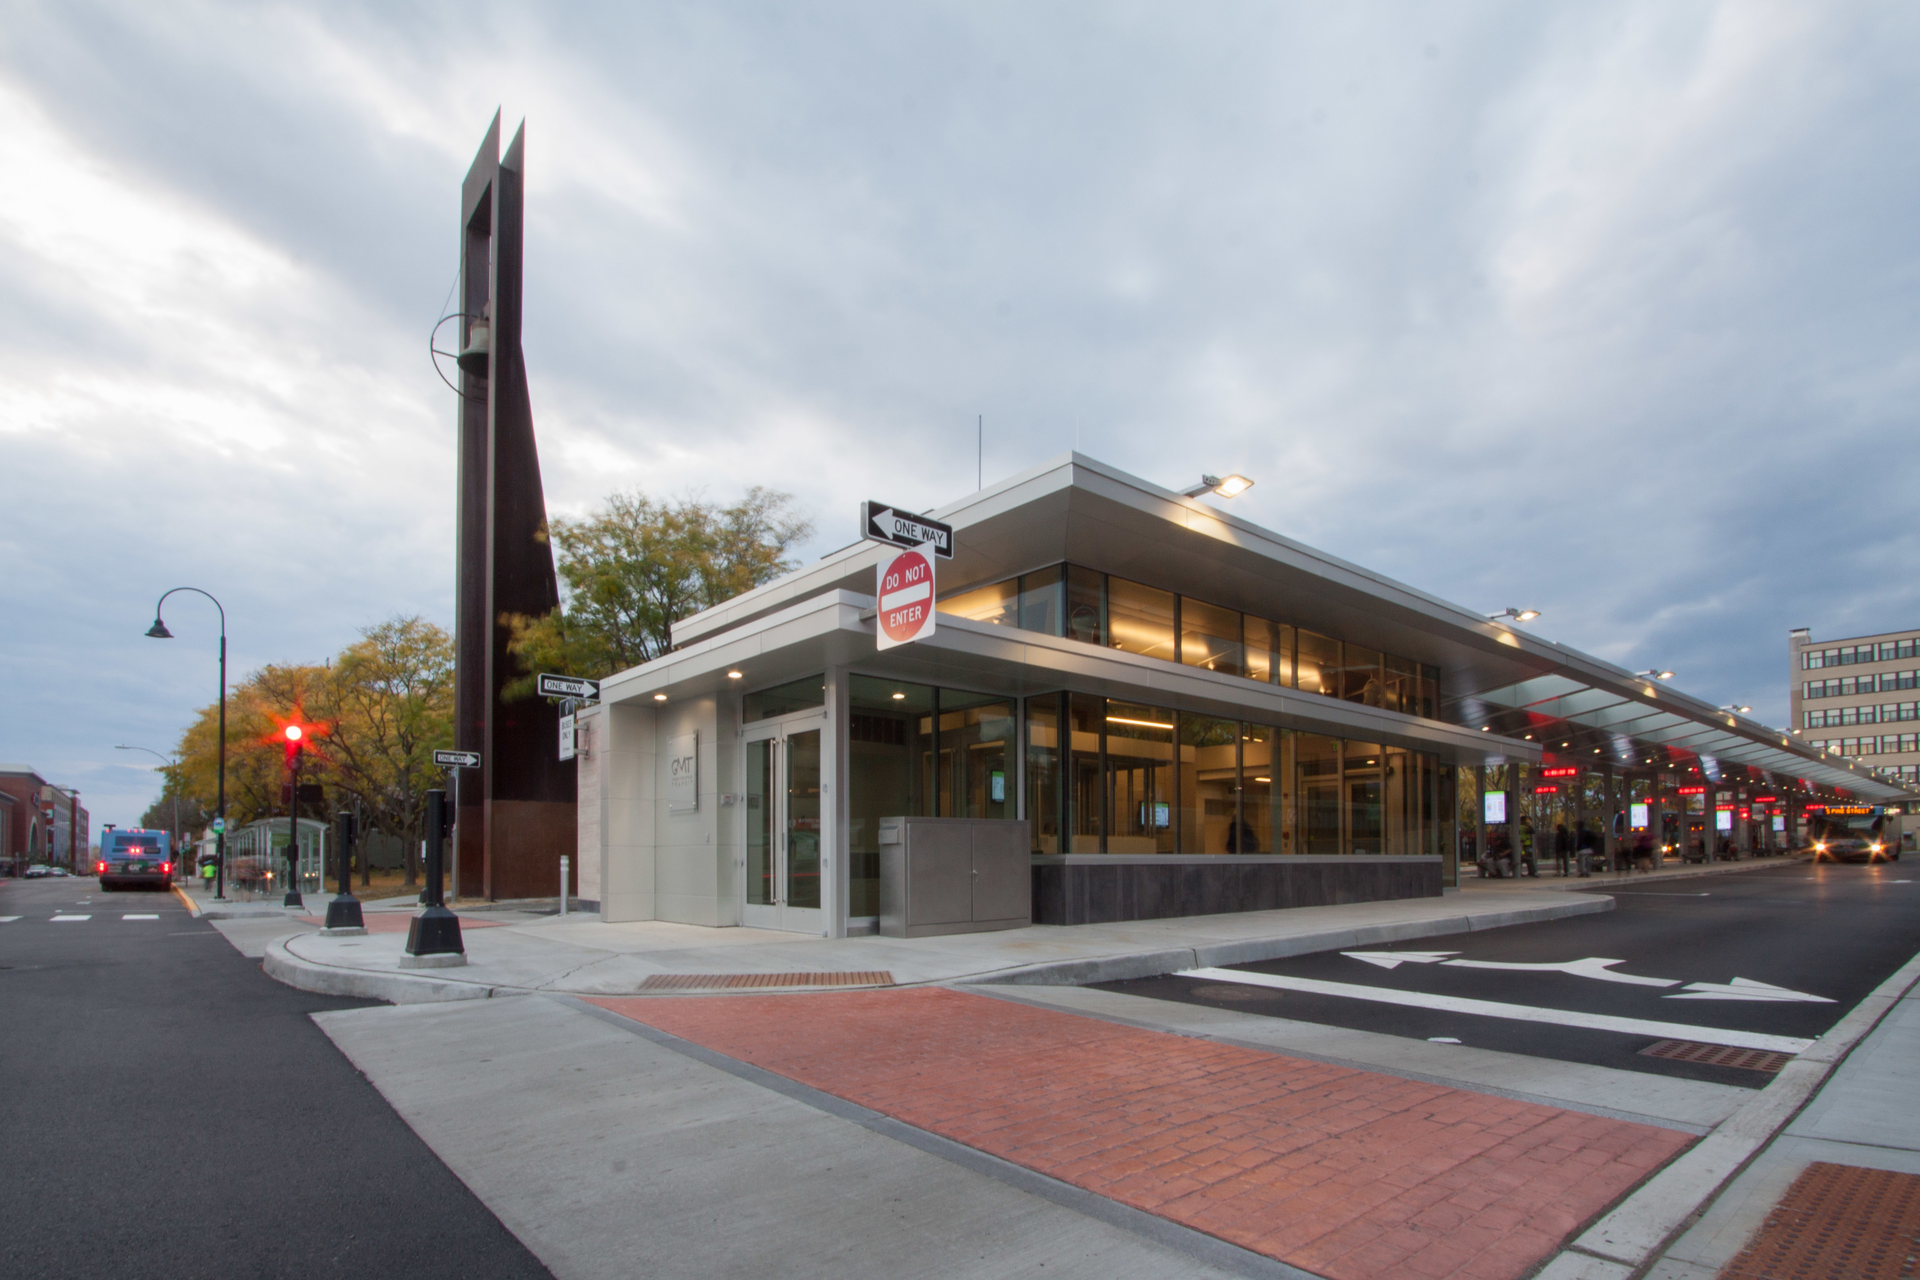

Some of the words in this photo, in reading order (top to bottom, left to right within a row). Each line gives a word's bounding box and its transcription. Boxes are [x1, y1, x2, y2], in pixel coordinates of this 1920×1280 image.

[894, 519, 918, 538] ONE
[921, 527, 944, 545] WAY
[886, 573, 899, 590] DO
[905, 563, 926, 583] NOT
[890, 605, 922, 628] ENTER
[546, 680, 564, 691] ONE
[566, 683, 583, 692] WAY
[671, 756, 694, 776] GMT
[1831, 807, 1845, 815] PINE
[1846, 807, 1870, 815] STREET
